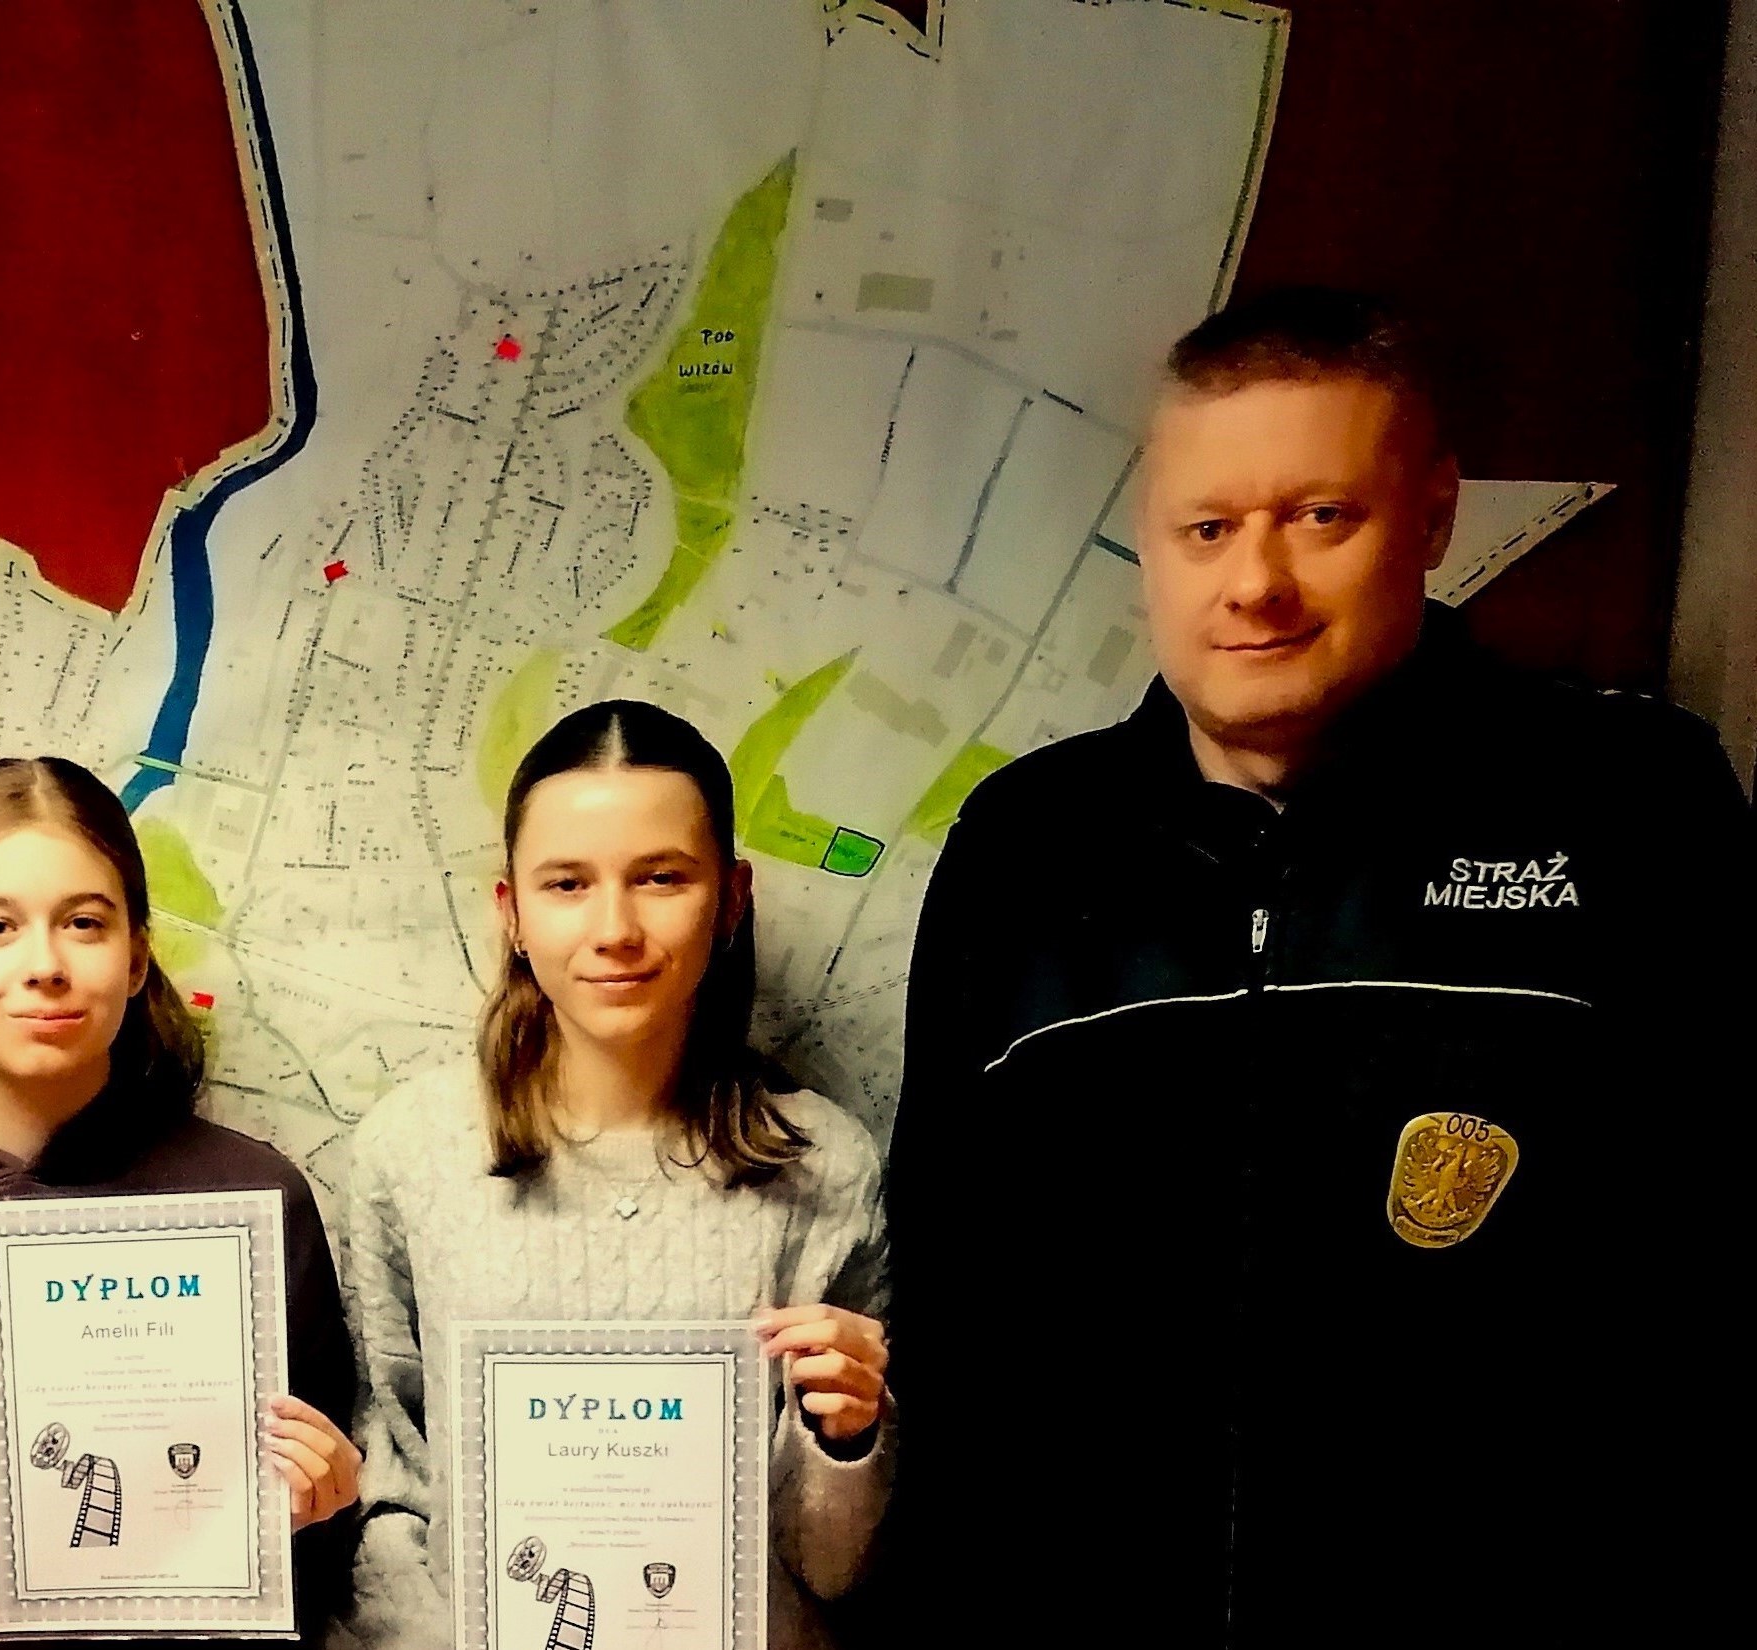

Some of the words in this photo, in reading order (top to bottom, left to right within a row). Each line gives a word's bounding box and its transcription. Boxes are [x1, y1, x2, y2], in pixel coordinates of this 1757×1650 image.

[1449, 851, 1570, 884] STRAŻ
[1423, 881, 1581, 910] MIEJSKA
[1446, 1114, 1493, 1142] 005
[46, 1273, 201, 1302] DYPLOM
[81, 1323, 139, 1340] Amelii
[146, 1321, 175, 1337] Fili
[528, 1393, 684, 1421] DYPLOM
[547, 1442, 600, 1461] Laury
[606, 1442, 670, 1458] Kuszki
